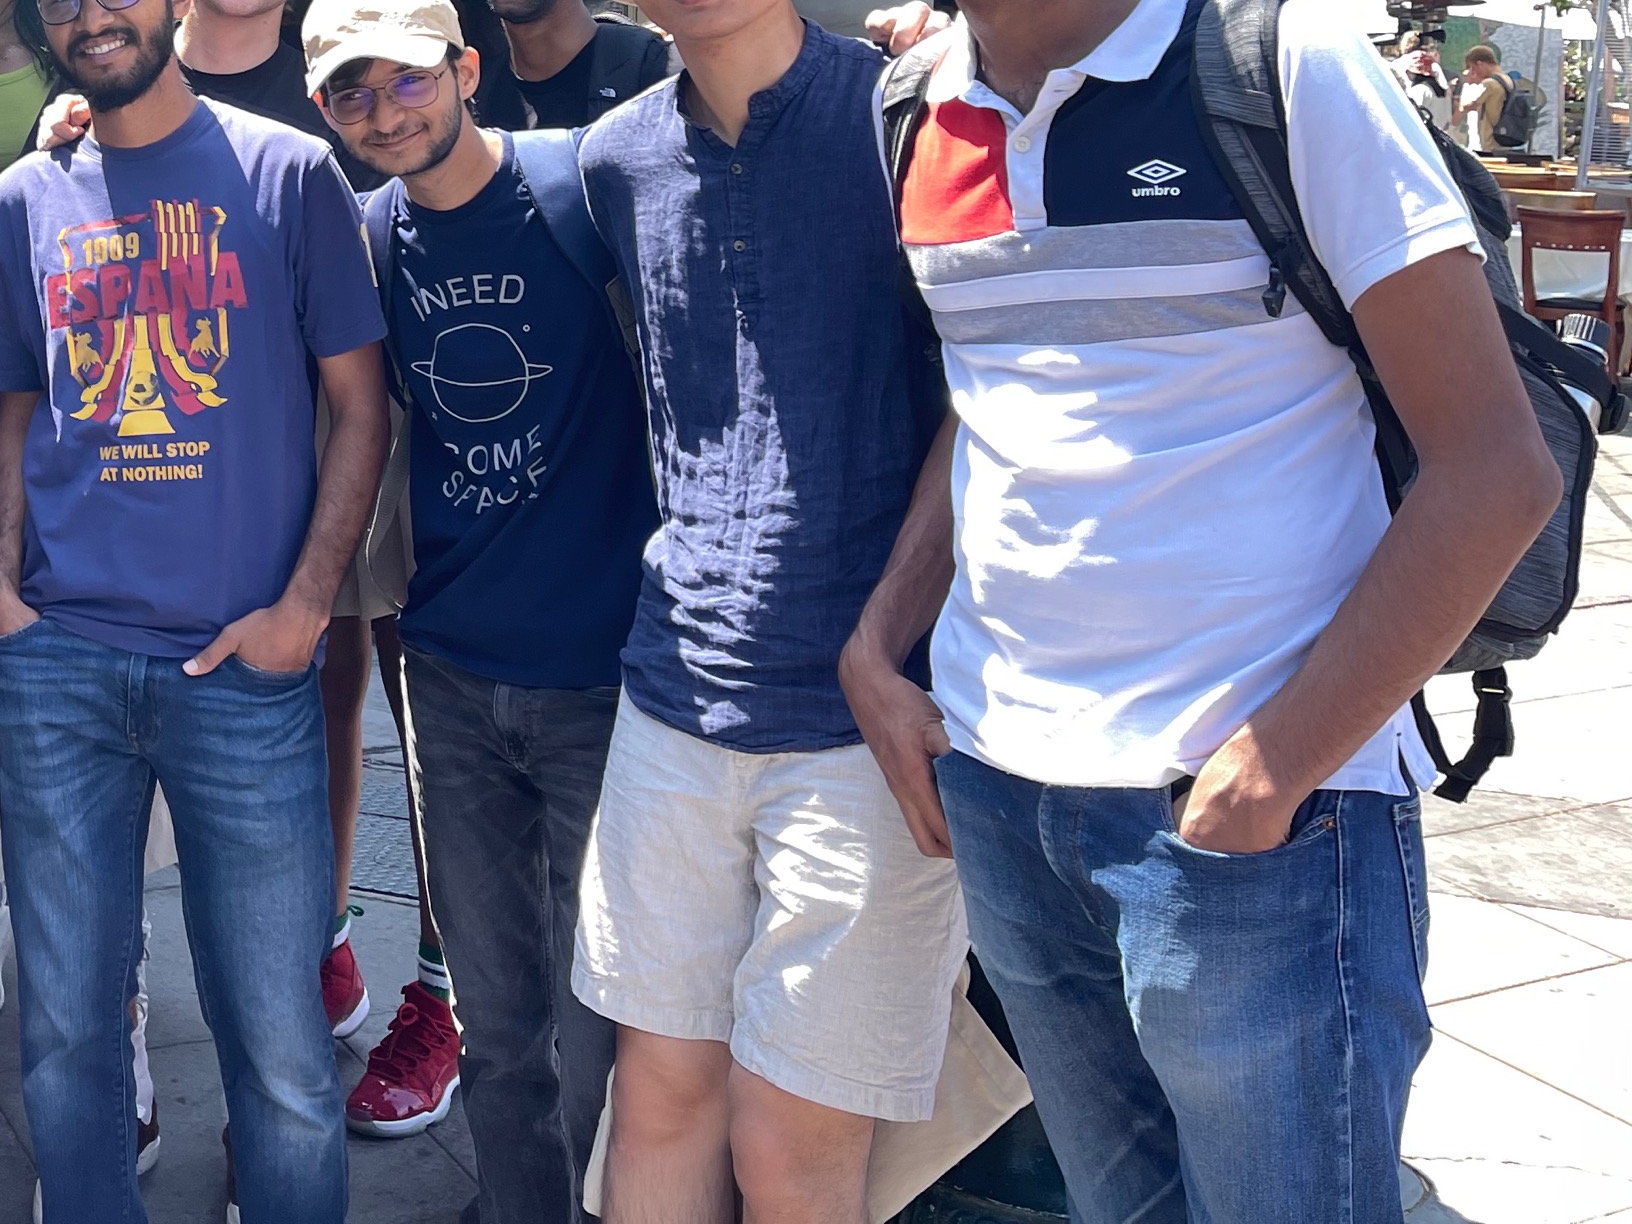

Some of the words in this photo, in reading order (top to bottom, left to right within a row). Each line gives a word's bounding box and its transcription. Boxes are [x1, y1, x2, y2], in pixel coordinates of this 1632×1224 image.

[1131, 184, 1181, 198] umbro
[81, 231, 140, 267] 1909
[410, 295, 426, 322] I
[419, 274, 525, 315] NEED
[99, 445, 120, 461] WE
[121, 443, 163, 460] WILL
[166, 441, 211, 458] STOP
[100, 466, 119, 482] AT
[121, 464, 204, 482] NOTHING!
